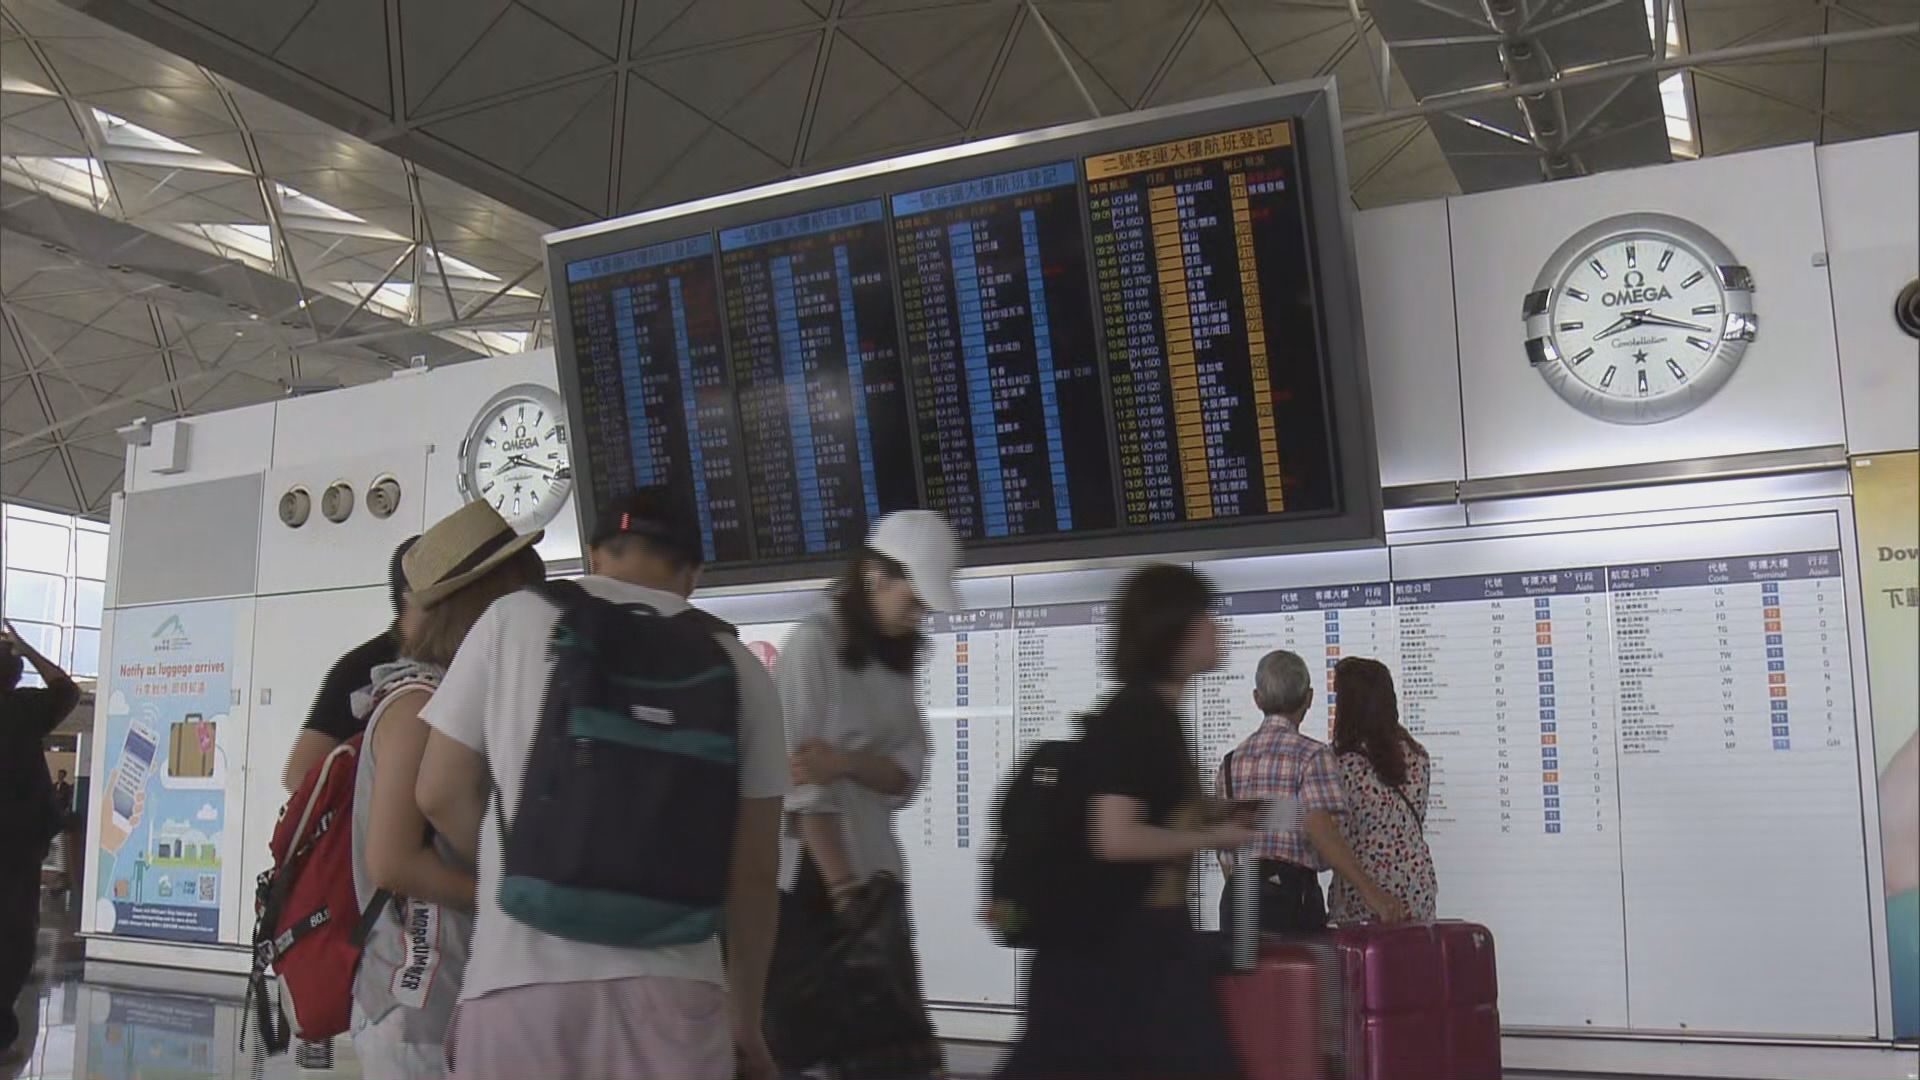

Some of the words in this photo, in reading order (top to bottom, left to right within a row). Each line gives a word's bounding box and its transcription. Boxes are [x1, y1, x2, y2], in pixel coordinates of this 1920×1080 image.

[1103, 127, 1274, 172] 二號客運大樓航班登記
[1602, 285, 1672, 308] OMEGA
[502, 436, 539, 452] OMEGA
[1611, 568, 1650, 580] 航空公司
[1708, 562, 1728, 574] 代號
[120, 663, 145, 679] Notify
[147, 665, 156, 676] as
[158, 661, 192, 678] luggage
[194, 659, 225, 673] arrives
